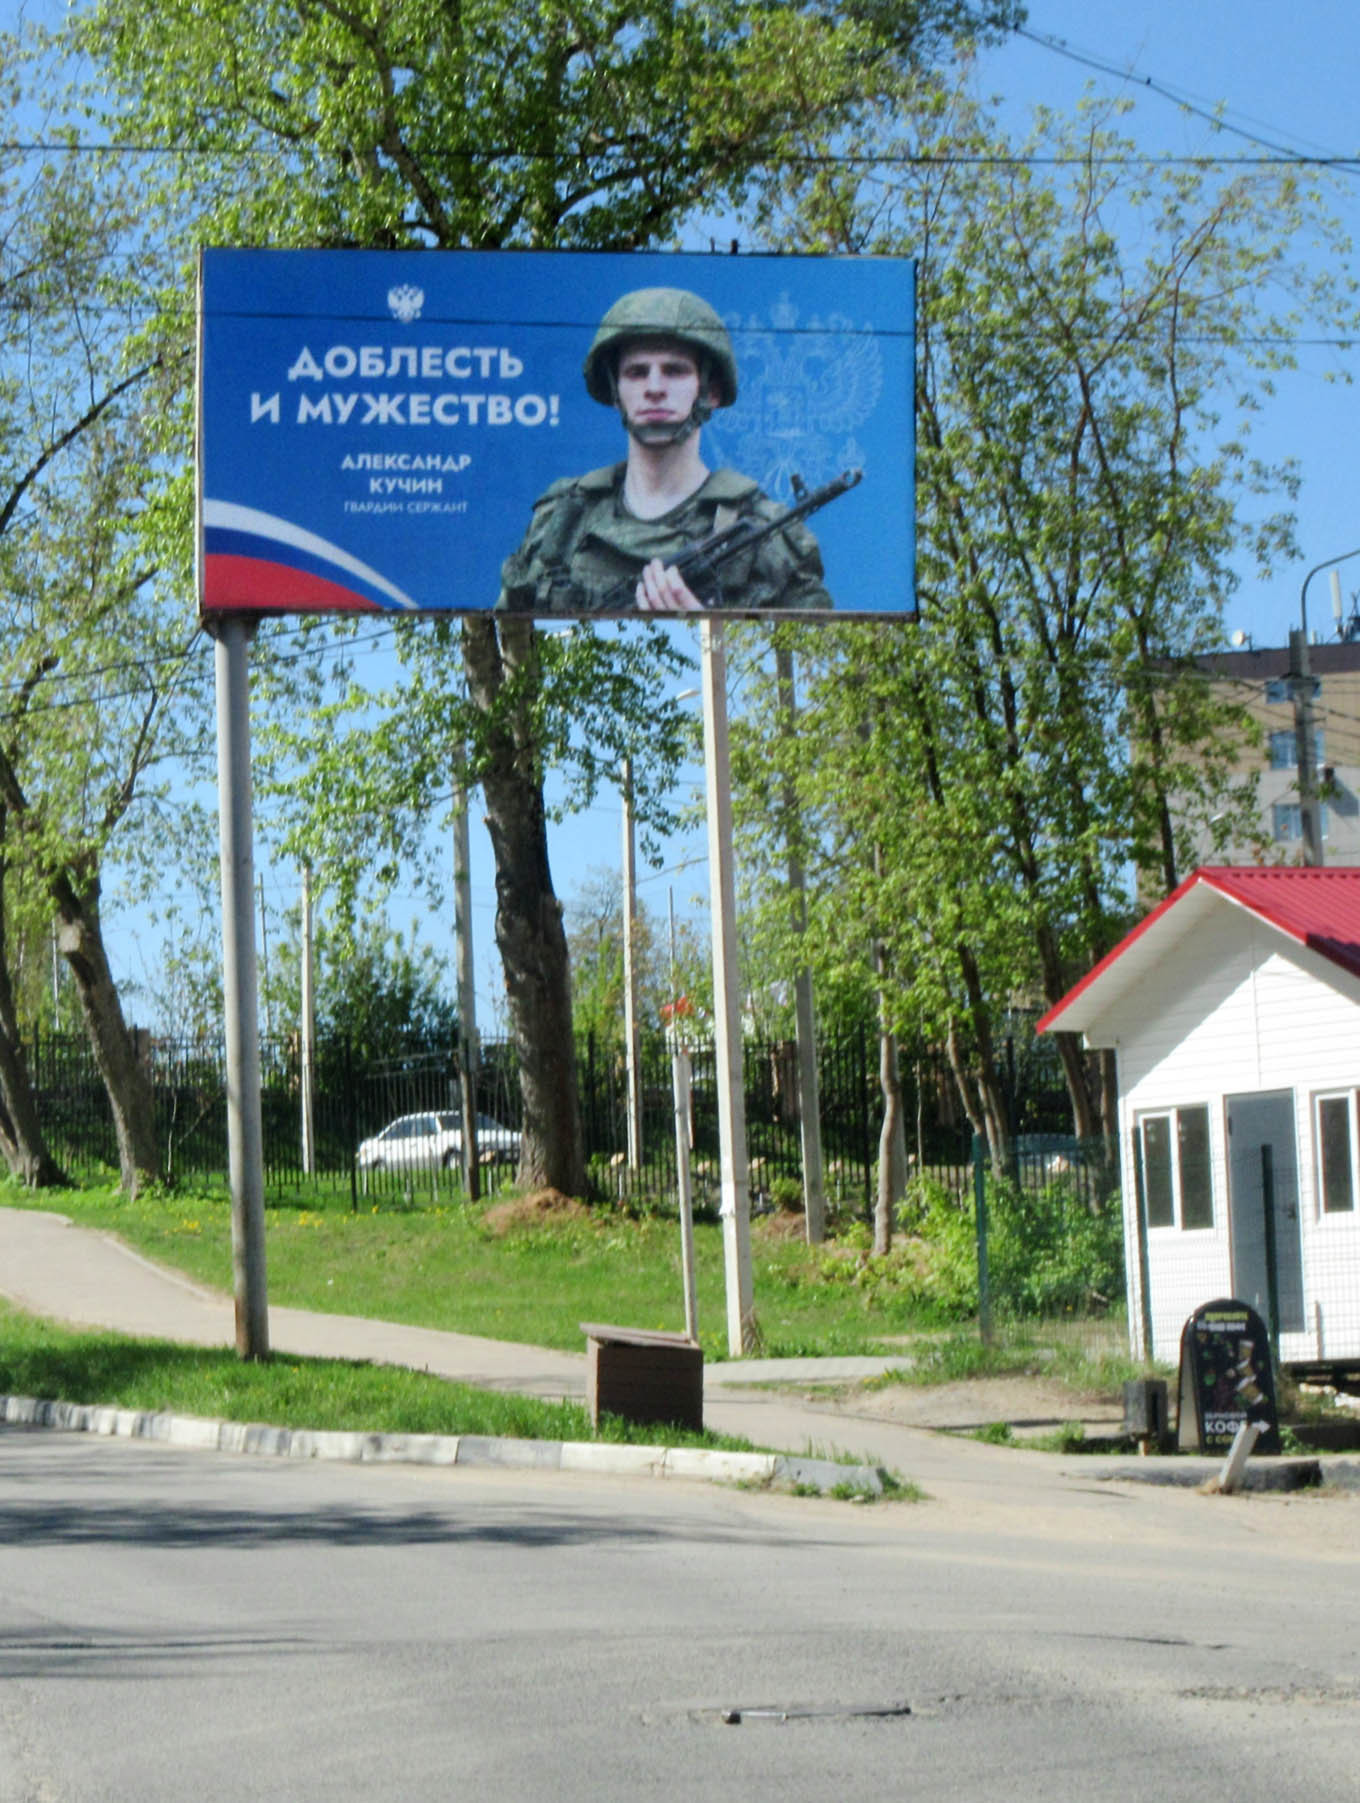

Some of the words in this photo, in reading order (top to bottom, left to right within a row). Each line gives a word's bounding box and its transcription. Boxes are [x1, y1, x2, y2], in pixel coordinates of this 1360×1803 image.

[287, 345, 524, 381] ДОБЛЕСТЬ
[250, 392, 280, 425] И
[296, 392, 560, 427] МУЖЕСТВО!
[341, 453, 472, 472] АЛЕКСАНДР
[369, 477, 443, 494] КУЧИН
